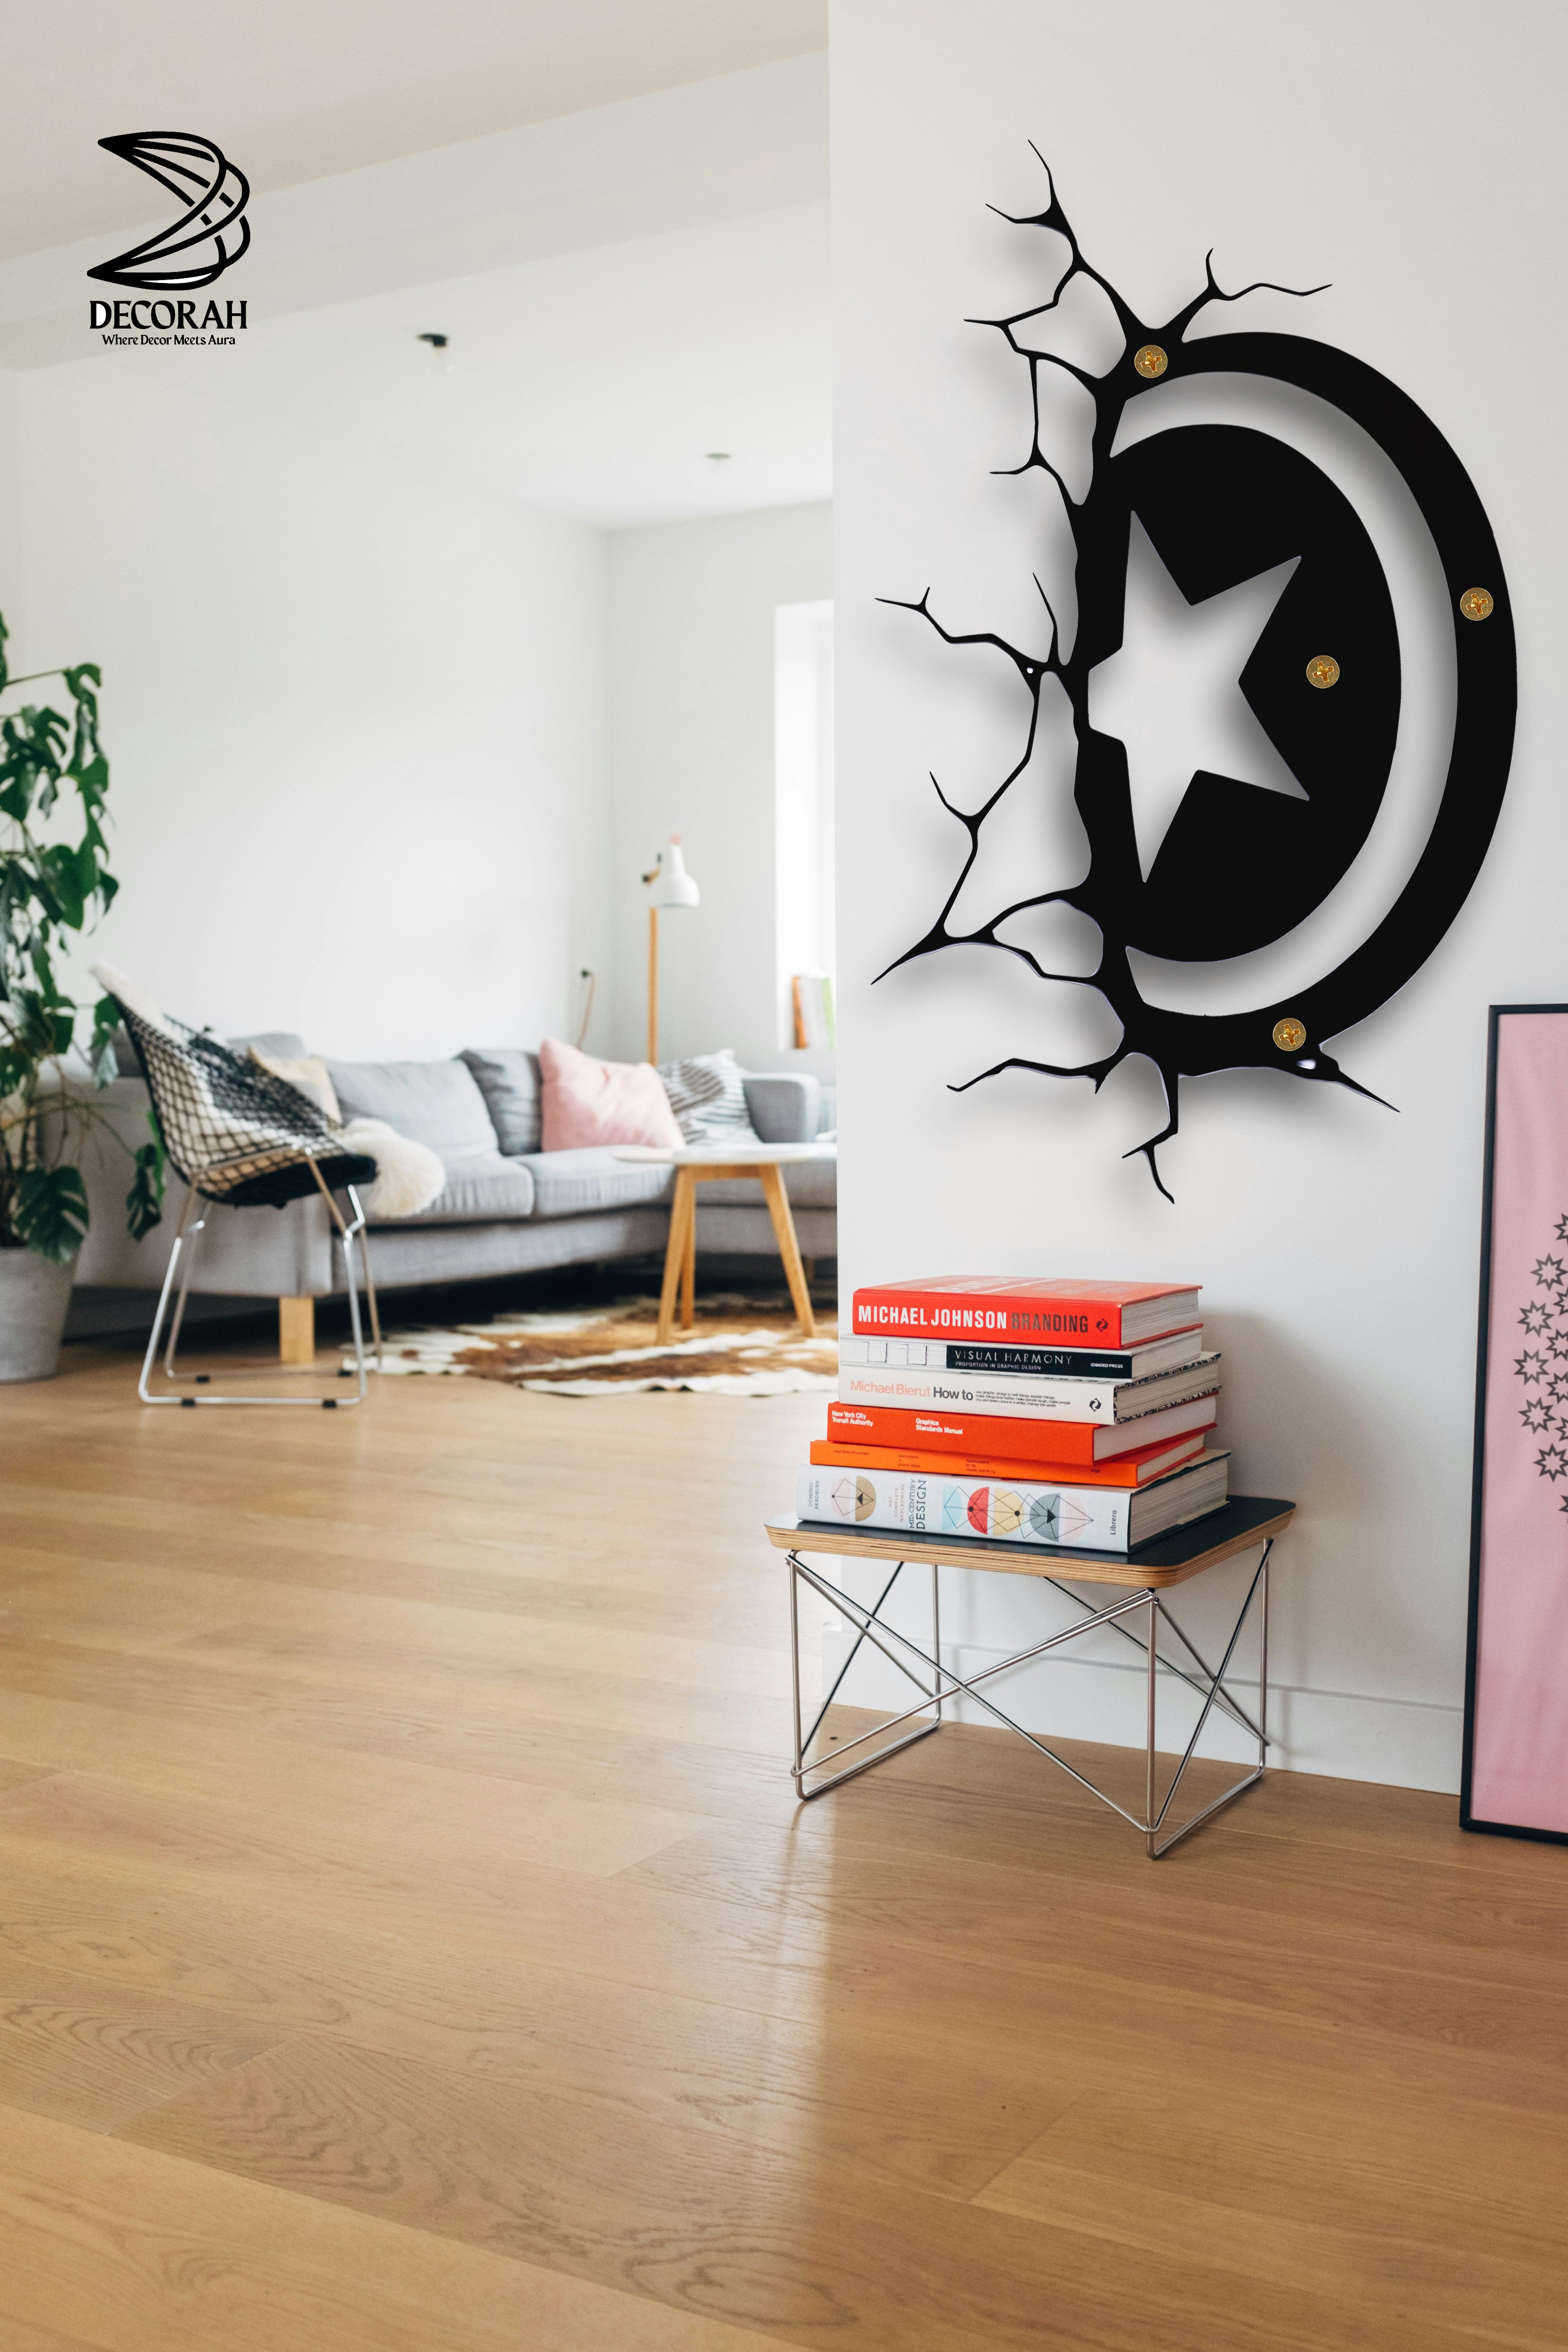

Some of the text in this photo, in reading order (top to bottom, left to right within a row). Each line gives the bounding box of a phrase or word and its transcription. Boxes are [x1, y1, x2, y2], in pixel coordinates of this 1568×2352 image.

[858, 1305, 1088, 1333] MICHAEL JOHNSON BRANDING
[955, 1350, 1072, 1365] VISUAL HARMONY
[850, 1380, 973, 1401] Michael Bierut How to
[850, 1418, 873, 1427] Authority
[916, 1418, 939, 1426] Graphics
[916, 1424, 943, 1433] Standards
[916, 1479, 927, 1530] DESIGN
